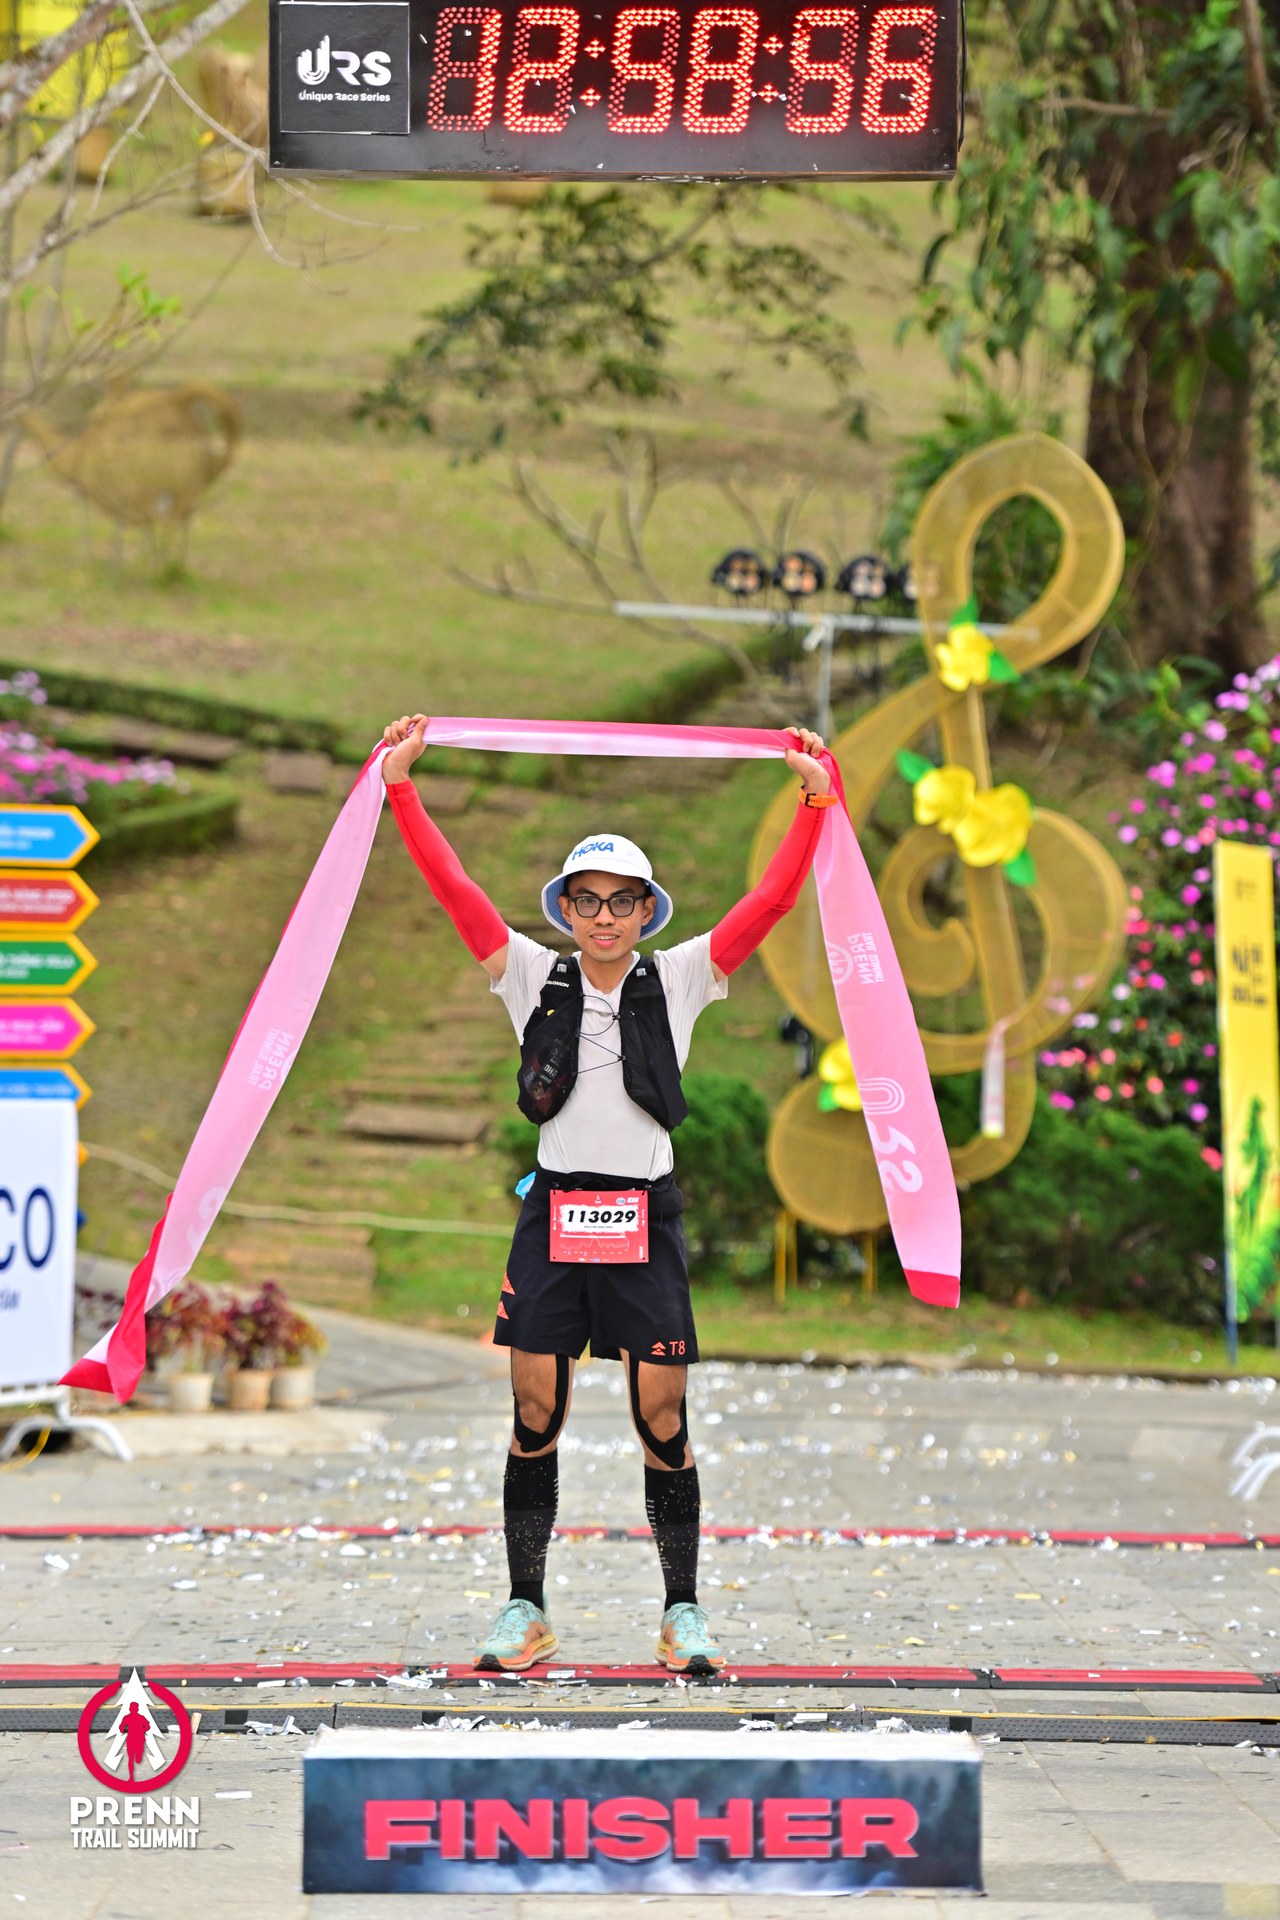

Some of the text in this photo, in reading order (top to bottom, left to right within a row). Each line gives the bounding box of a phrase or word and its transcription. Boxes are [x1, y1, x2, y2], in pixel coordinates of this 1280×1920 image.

[297, 35, 392, 86] URS
[466, 7, 938, 134] 12:58:56
[299, 89, 391, 102] Unique Race Series
[571, 841, 614, 861] HOKA
[568, 1210, 636, 1223] 113029
[669, 1340, 685, 1355] T8
[364, 1797, 919, 1862] FINISHER
